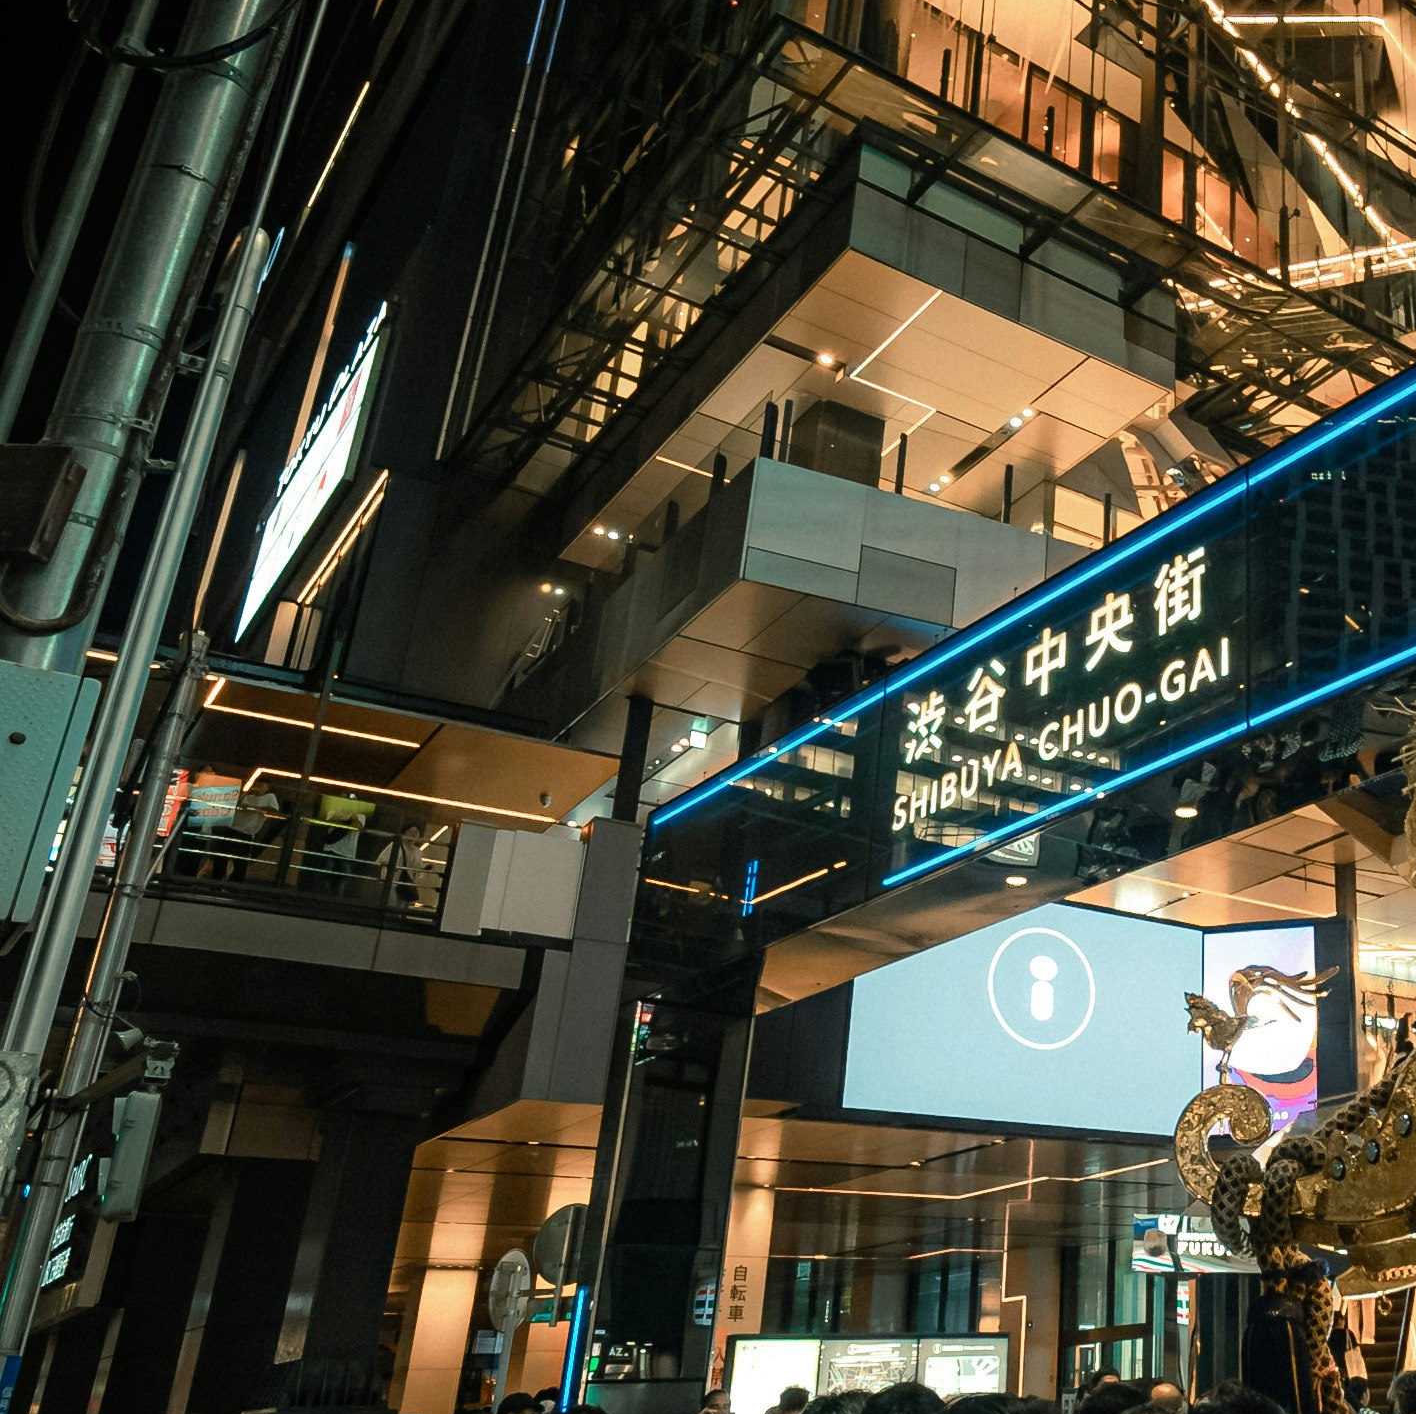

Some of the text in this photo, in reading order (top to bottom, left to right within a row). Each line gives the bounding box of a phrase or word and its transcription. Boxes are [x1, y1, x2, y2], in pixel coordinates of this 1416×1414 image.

[904, 546, 1208, 765] 渋谷中央街
[892, 637, 1231, 833] SHIBUYA CHUO-GAI
[726, 1264, 749, 1323] 自転車
[1177, 1241, 1232, 1258] FUKU
